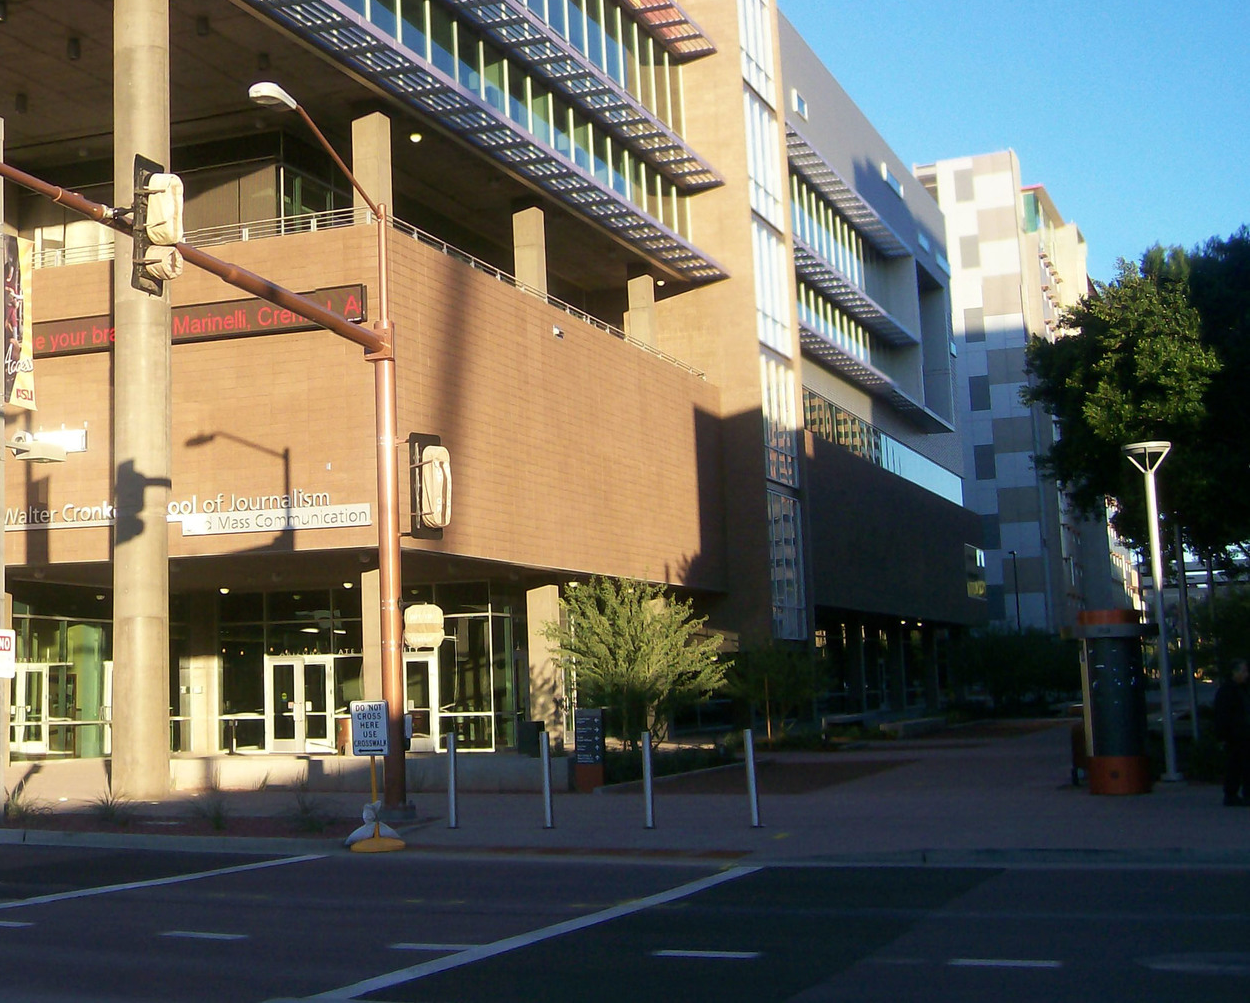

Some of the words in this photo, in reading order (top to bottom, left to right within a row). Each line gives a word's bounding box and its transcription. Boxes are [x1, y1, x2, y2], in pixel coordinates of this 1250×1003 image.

[49, 330, 88, 353] your
[92, 325, 116, 345] bra
[172, 308, 251, 337] Marinelli,
[344, 294, 361, 316] A
[4, 342, 34, 375] Access
[16, 388, 33, 401] ASU
[62, 500, 116, 523] Cronk
[167, 494, 197, 516] ool
[202, 493, 224, 514] of
[228, 488, 330, 513] Journalism
[217, 516, 250, 531] Mass
[254, 508, 368, 529] Communication
[0, 637, 10, 650] NO
[355, 704, 365, 712] DO
[357, 712, 382, 721] CROSS
[360, 721, 380, 729] HERE
[363, 730, 378, 738] USE
[354, 739, 387, 748] CROSSWALK
